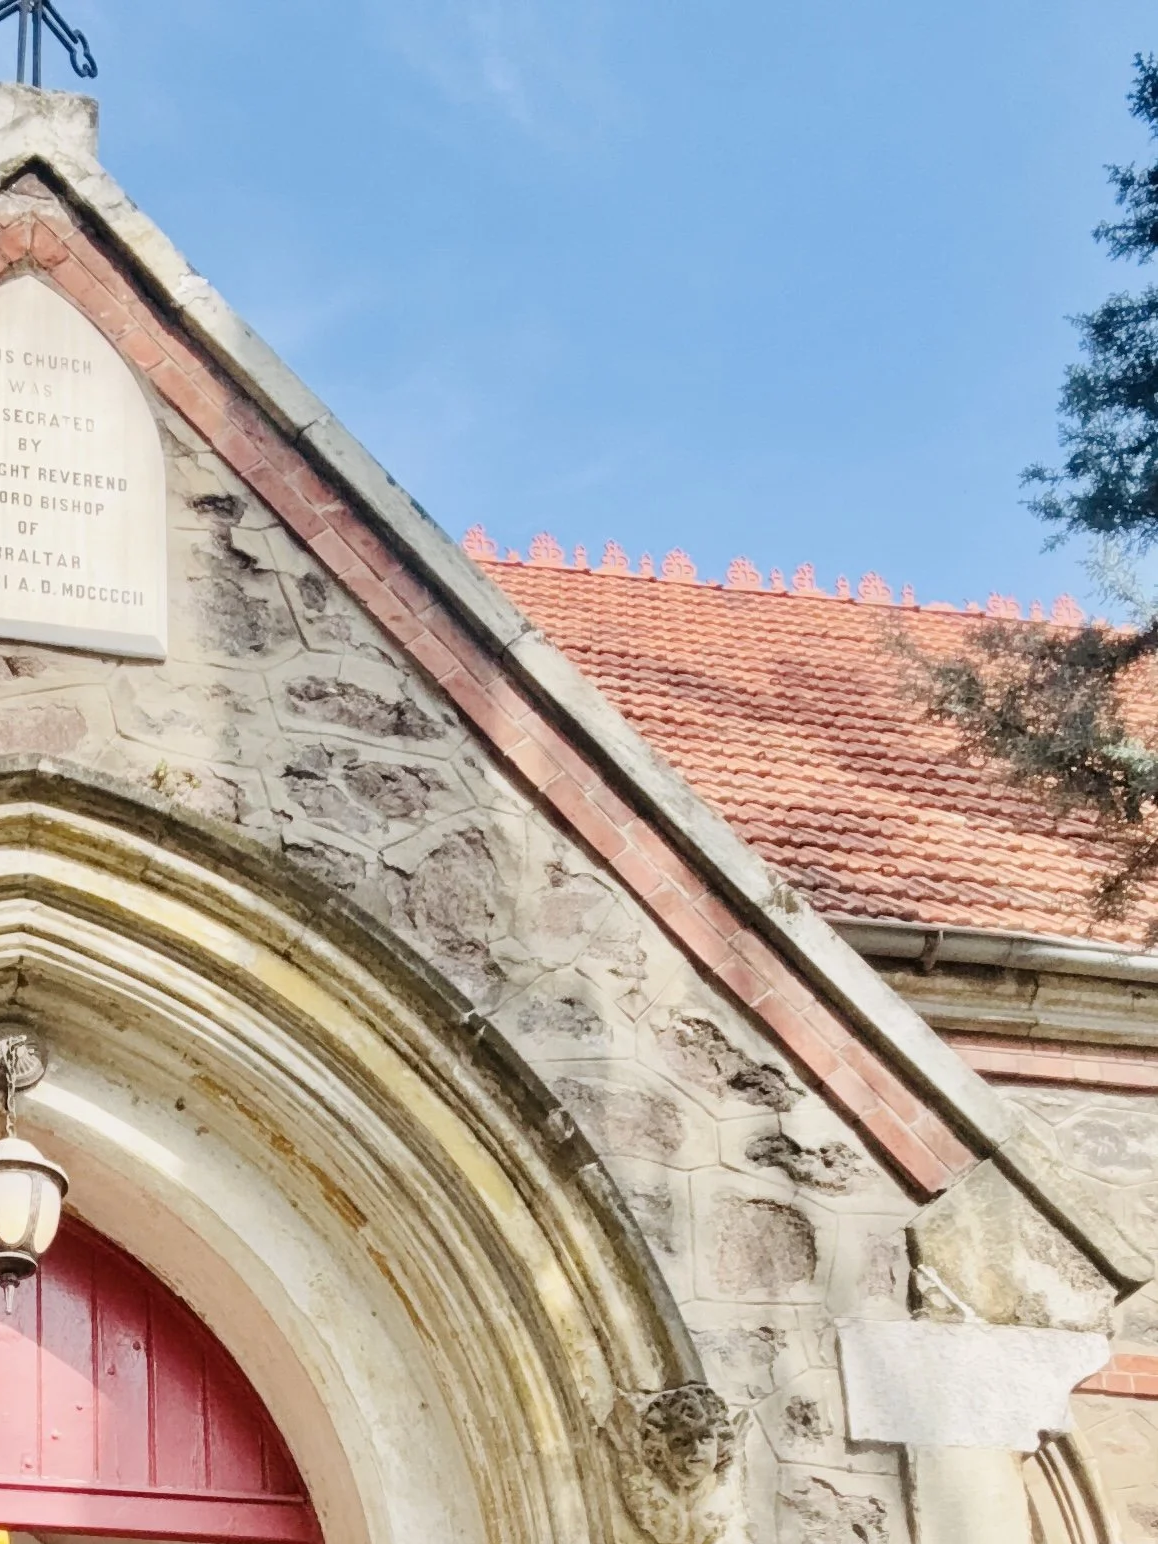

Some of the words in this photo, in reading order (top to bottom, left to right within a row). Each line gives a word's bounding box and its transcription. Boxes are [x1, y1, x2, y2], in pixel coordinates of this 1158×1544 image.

[24, 352, 92, 375] CHURCH
[8, 379, 52, 398] WAS
[18, 437, 42, 453] BY
[38, 467, 128, 492] REVEREND
[41, 496, 105, 516] BISHOP
[18, 520, 39, 536] OF
